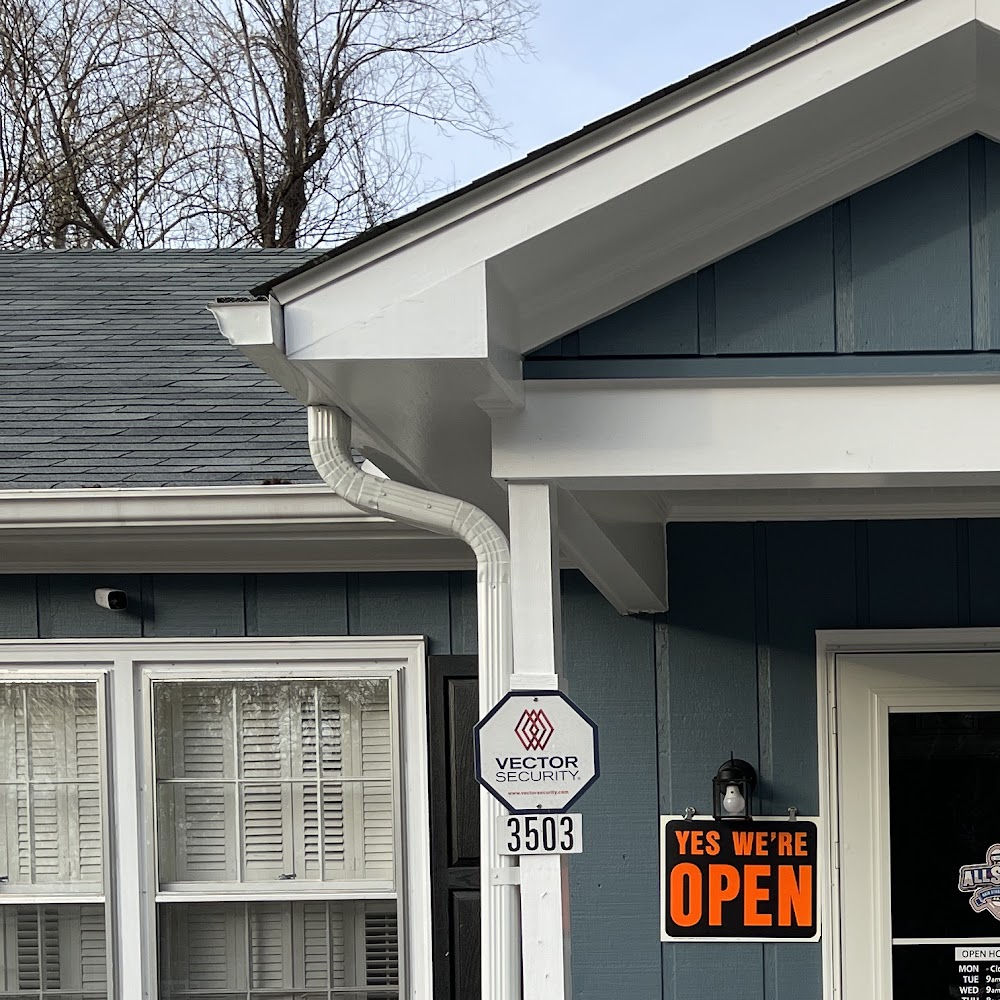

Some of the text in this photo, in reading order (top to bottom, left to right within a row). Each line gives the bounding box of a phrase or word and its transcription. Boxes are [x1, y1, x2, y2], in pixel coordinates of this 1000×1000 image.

[495, 756, 579, 770] VECTOR
[496, 770, 580, 783] SECURITY
[507, 816, 574, 852] 3503
[675, 830, 808, 857] YES WE'RE
[670, 862, 813, 928] OPEN
[962, 950, 986, 958] OPEN
